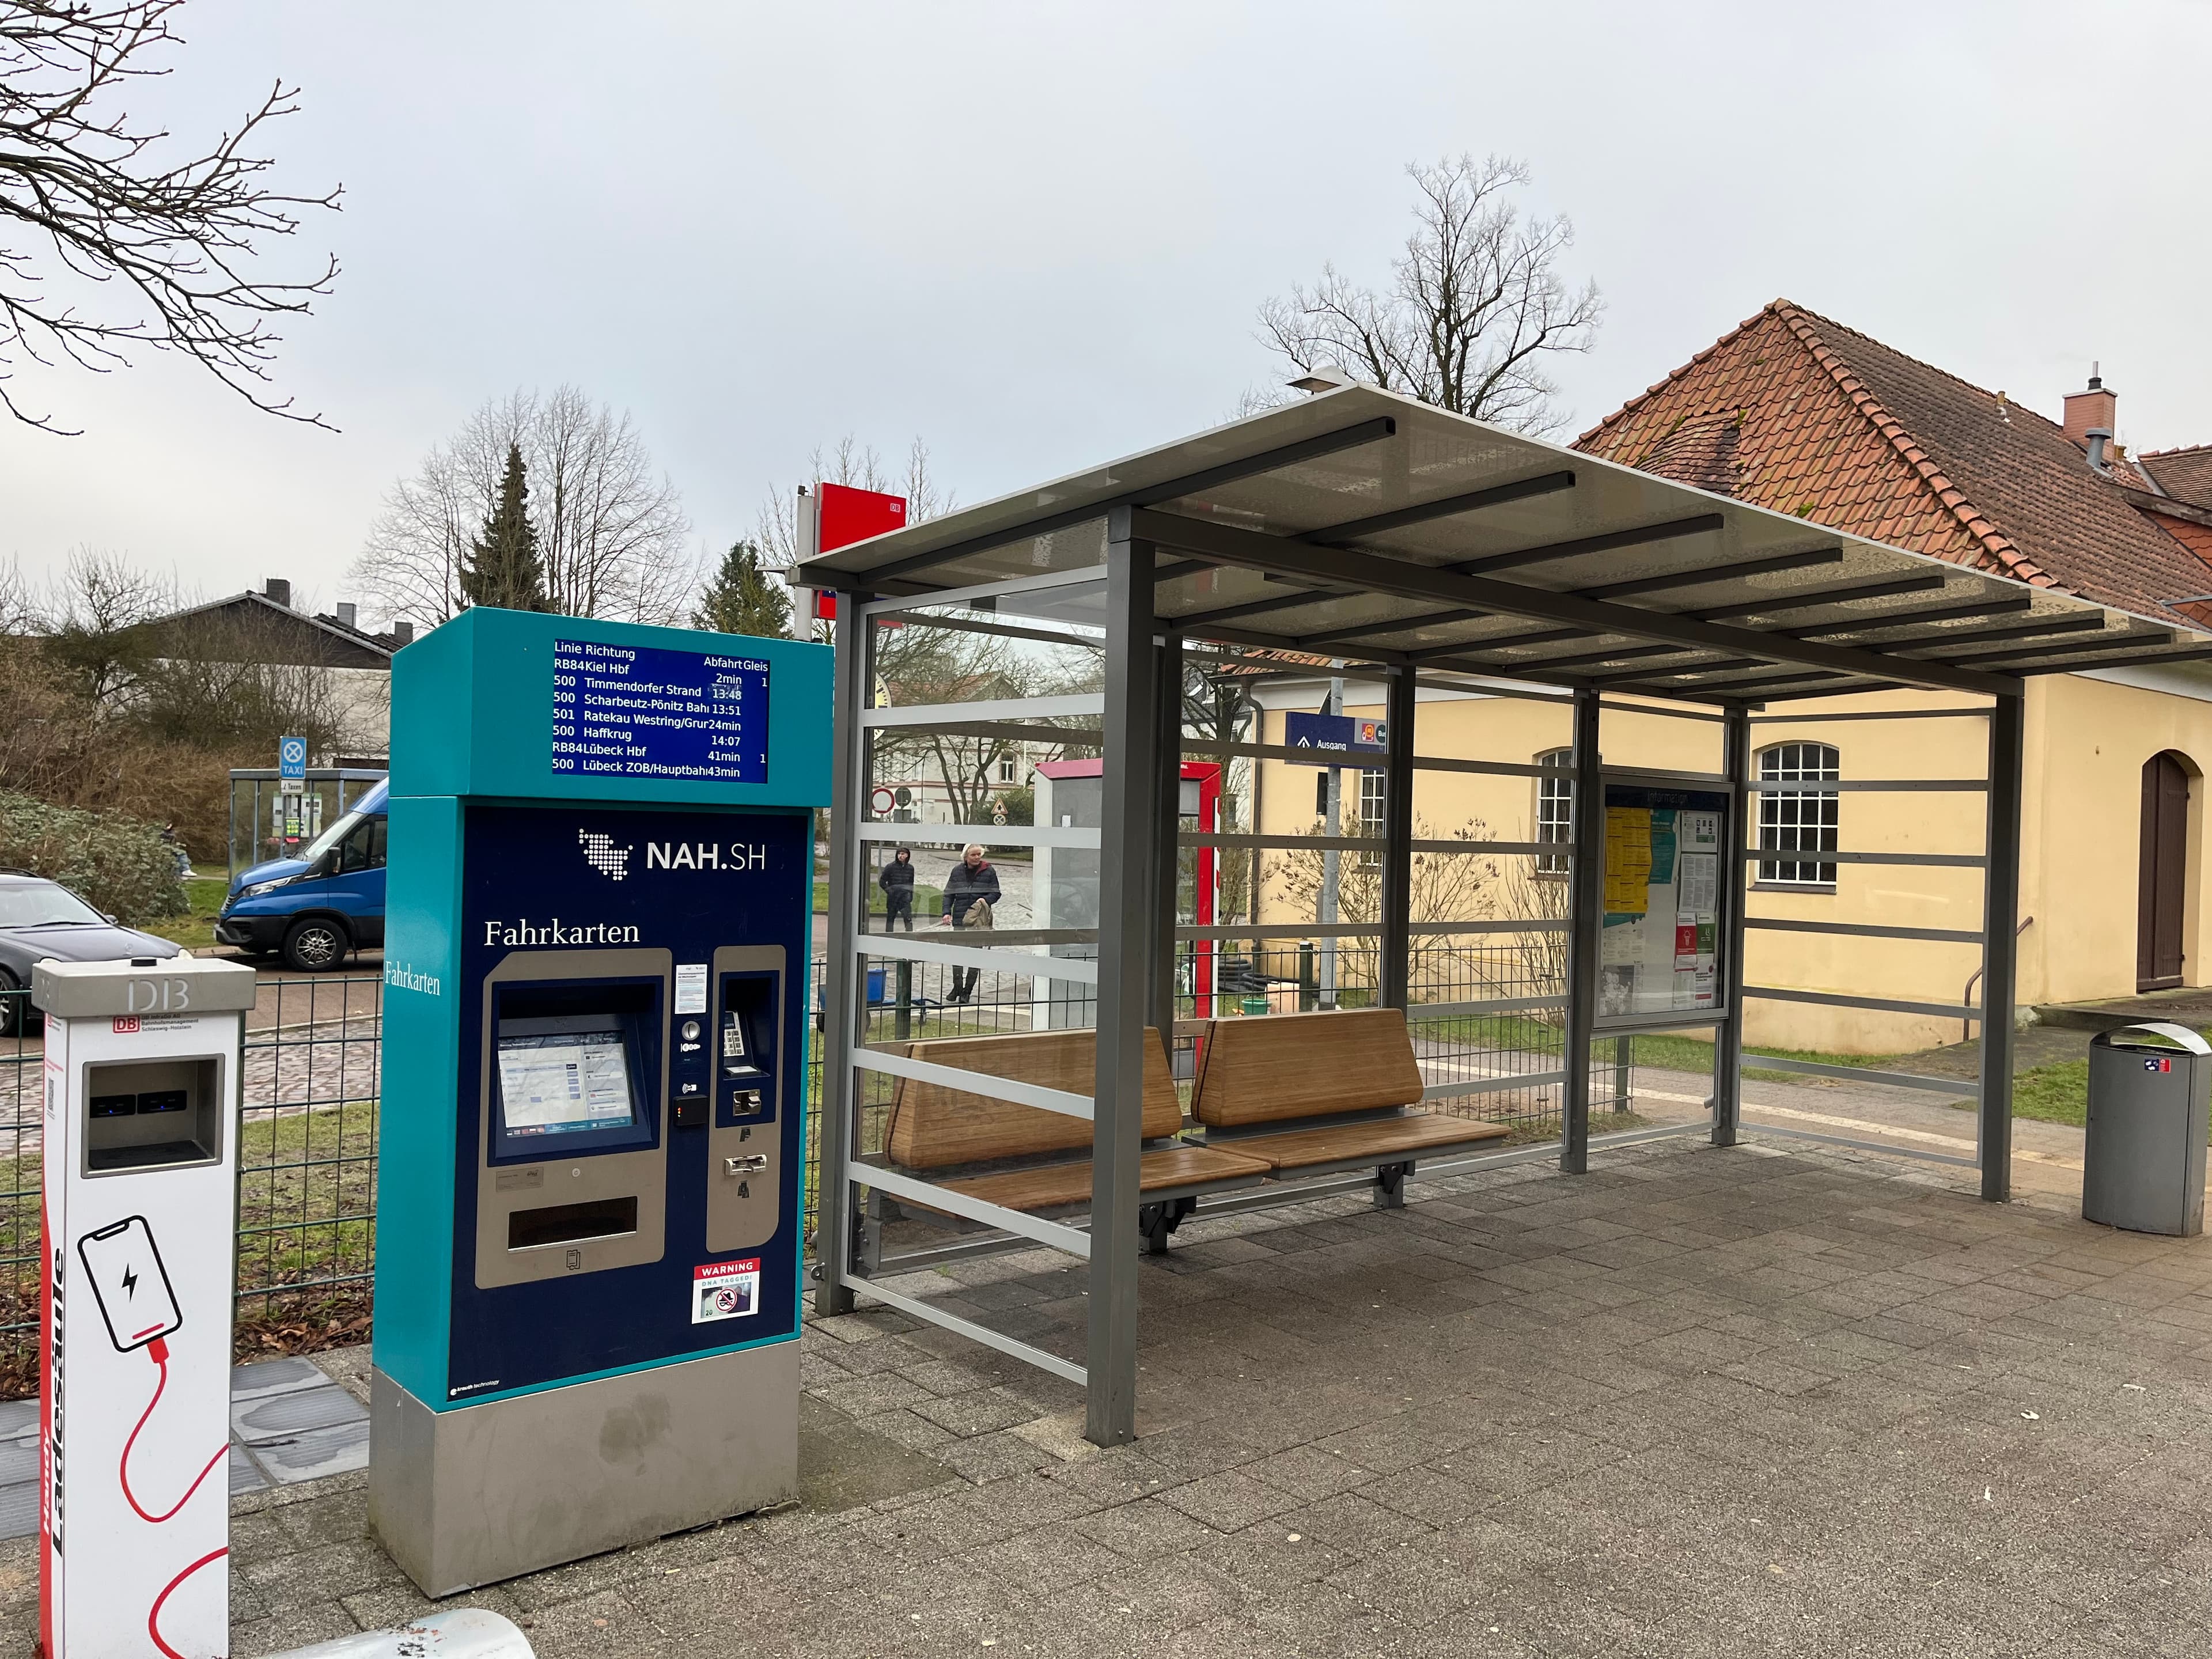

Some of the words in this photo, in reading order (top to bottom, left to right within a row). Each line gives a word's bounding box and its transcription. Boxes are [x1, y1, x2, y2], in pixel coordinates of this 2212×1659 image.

[555, 642, 582, 654] Linie
[586, 645, 635, 661] Richtung
[704, 657, 742, 669] Abfahrt
[744, 661, 768, 671] Gleis
[554, 658, 584, 671] RB84
[585, 661, 605, 672] Kiel
[609, 664, 630, 675] Hbf
[716, 673, 742, 684] 2min
[762, 678, 767, 687] 1
[554, 675, 575, 686] 500
[585, 677, 664, 694] Timmendorfer
[666, 684, 702, 697] Strand
[713, 688, 742, 700] 13:48
[554, 692, 575, 703] 500
[585, 694, 683, 711] Scharbeutz-Pönitz
[713, 704, 741, 715] 13:51
[553, 709, 574, 719] 501
[585, 711, 630, 723] Ratekau
[709, 719, 741, 731] 24min
[553, 725, 575, 736] 500
[584, 727, 632, 742] Haffkrug
[712, 736, 741, 746] 14:07
[1317, 740, 1346, 751] Ausgang
[553, 742, 583, 753] RB84
[584, 744, 623, 755] Lübeck
[627, 746, 647, 756] Hbf
[707, 751, 740, 762] 41min
[760, 754, 766, 763] 1
[283, 765, 303, 775] TAXI
[552, 759, 574, 769] 500
[583, 760, 623, 771] Lübeck
[707, 767, 740, 777] 43min
[647, 842, 765, 870] NAH.SH
[484, 918, 640, 946] Fahrkarten
[385, 961, 440, 995] Fahrkarten
[128, 979, 190, 1012] DB
[116, 1018, 137, 1030] DB
[702, 1262, 753, 1277] WARNING
[721, 1275, 752, 1284] TAGGED!
[52, 1248, 65, 1557] Ladesäule
[43, 1426, 51, 1536] Handy
